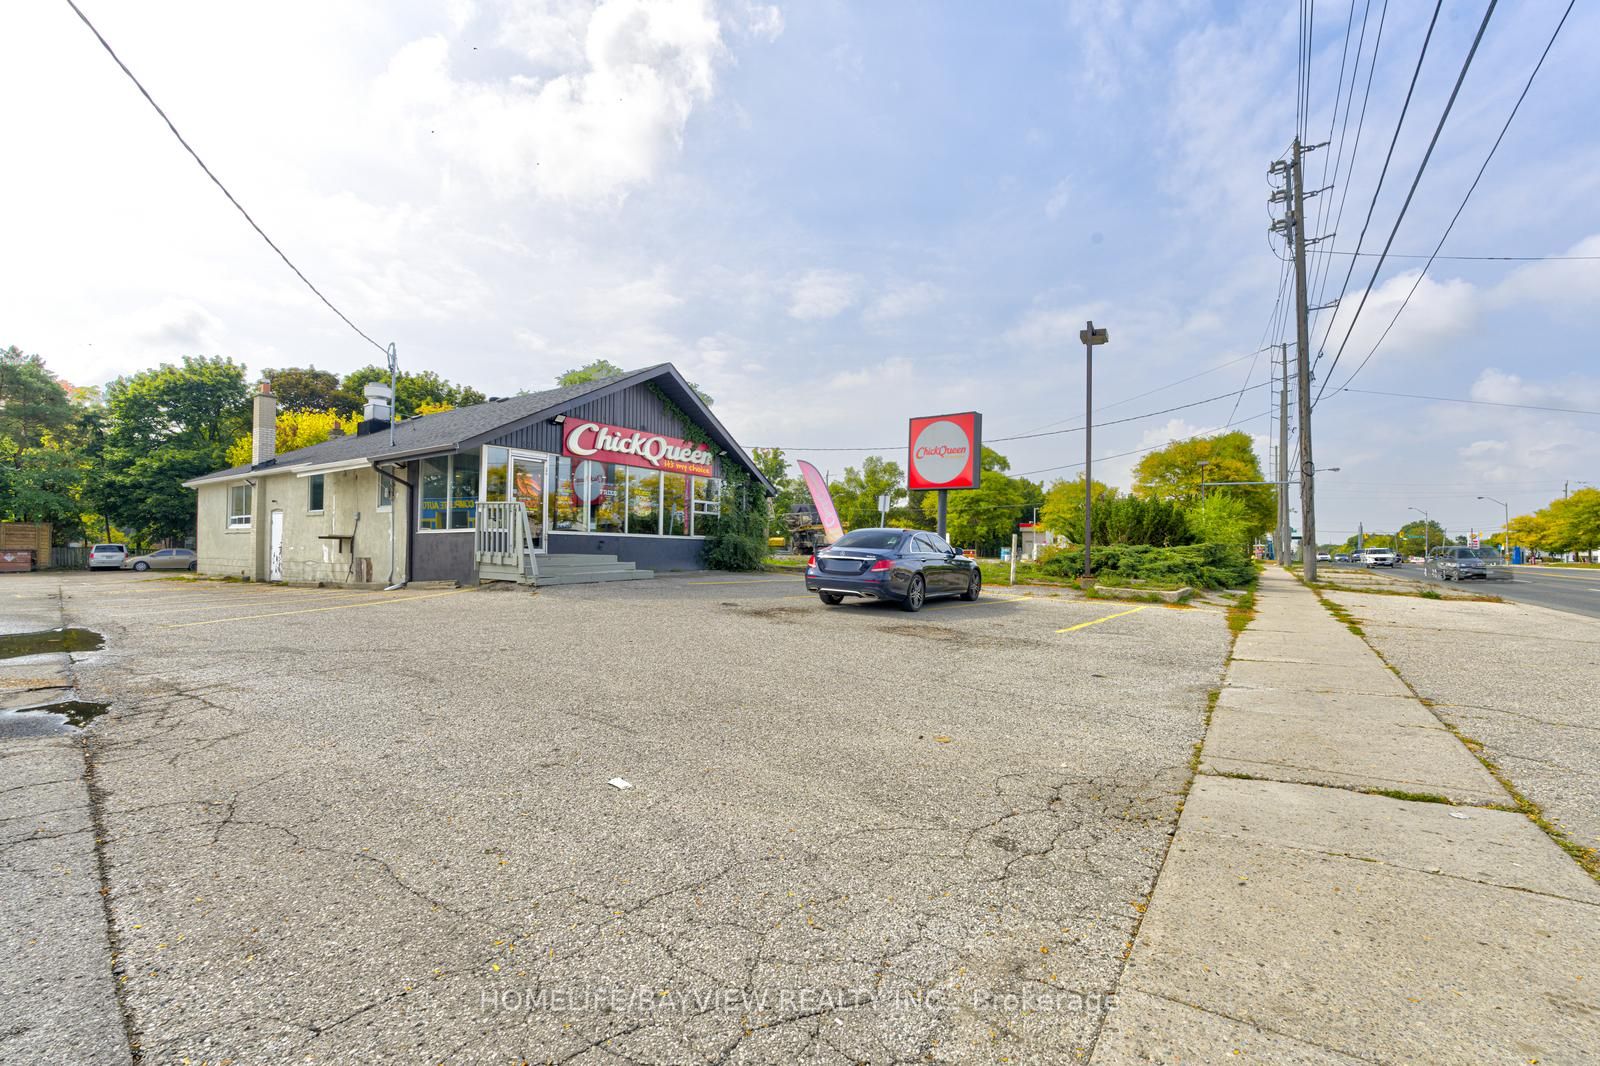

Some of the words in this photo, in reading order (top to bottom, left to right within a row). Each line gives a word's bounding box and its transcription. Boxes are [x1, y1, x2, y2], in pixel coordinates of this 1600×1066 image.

[567, 423, 713, 466] ChickQueen
[915, 445, 966, 460] ChickQueen
[676, 463, 687, 472] my
[687, 464, 710, 474] choice
